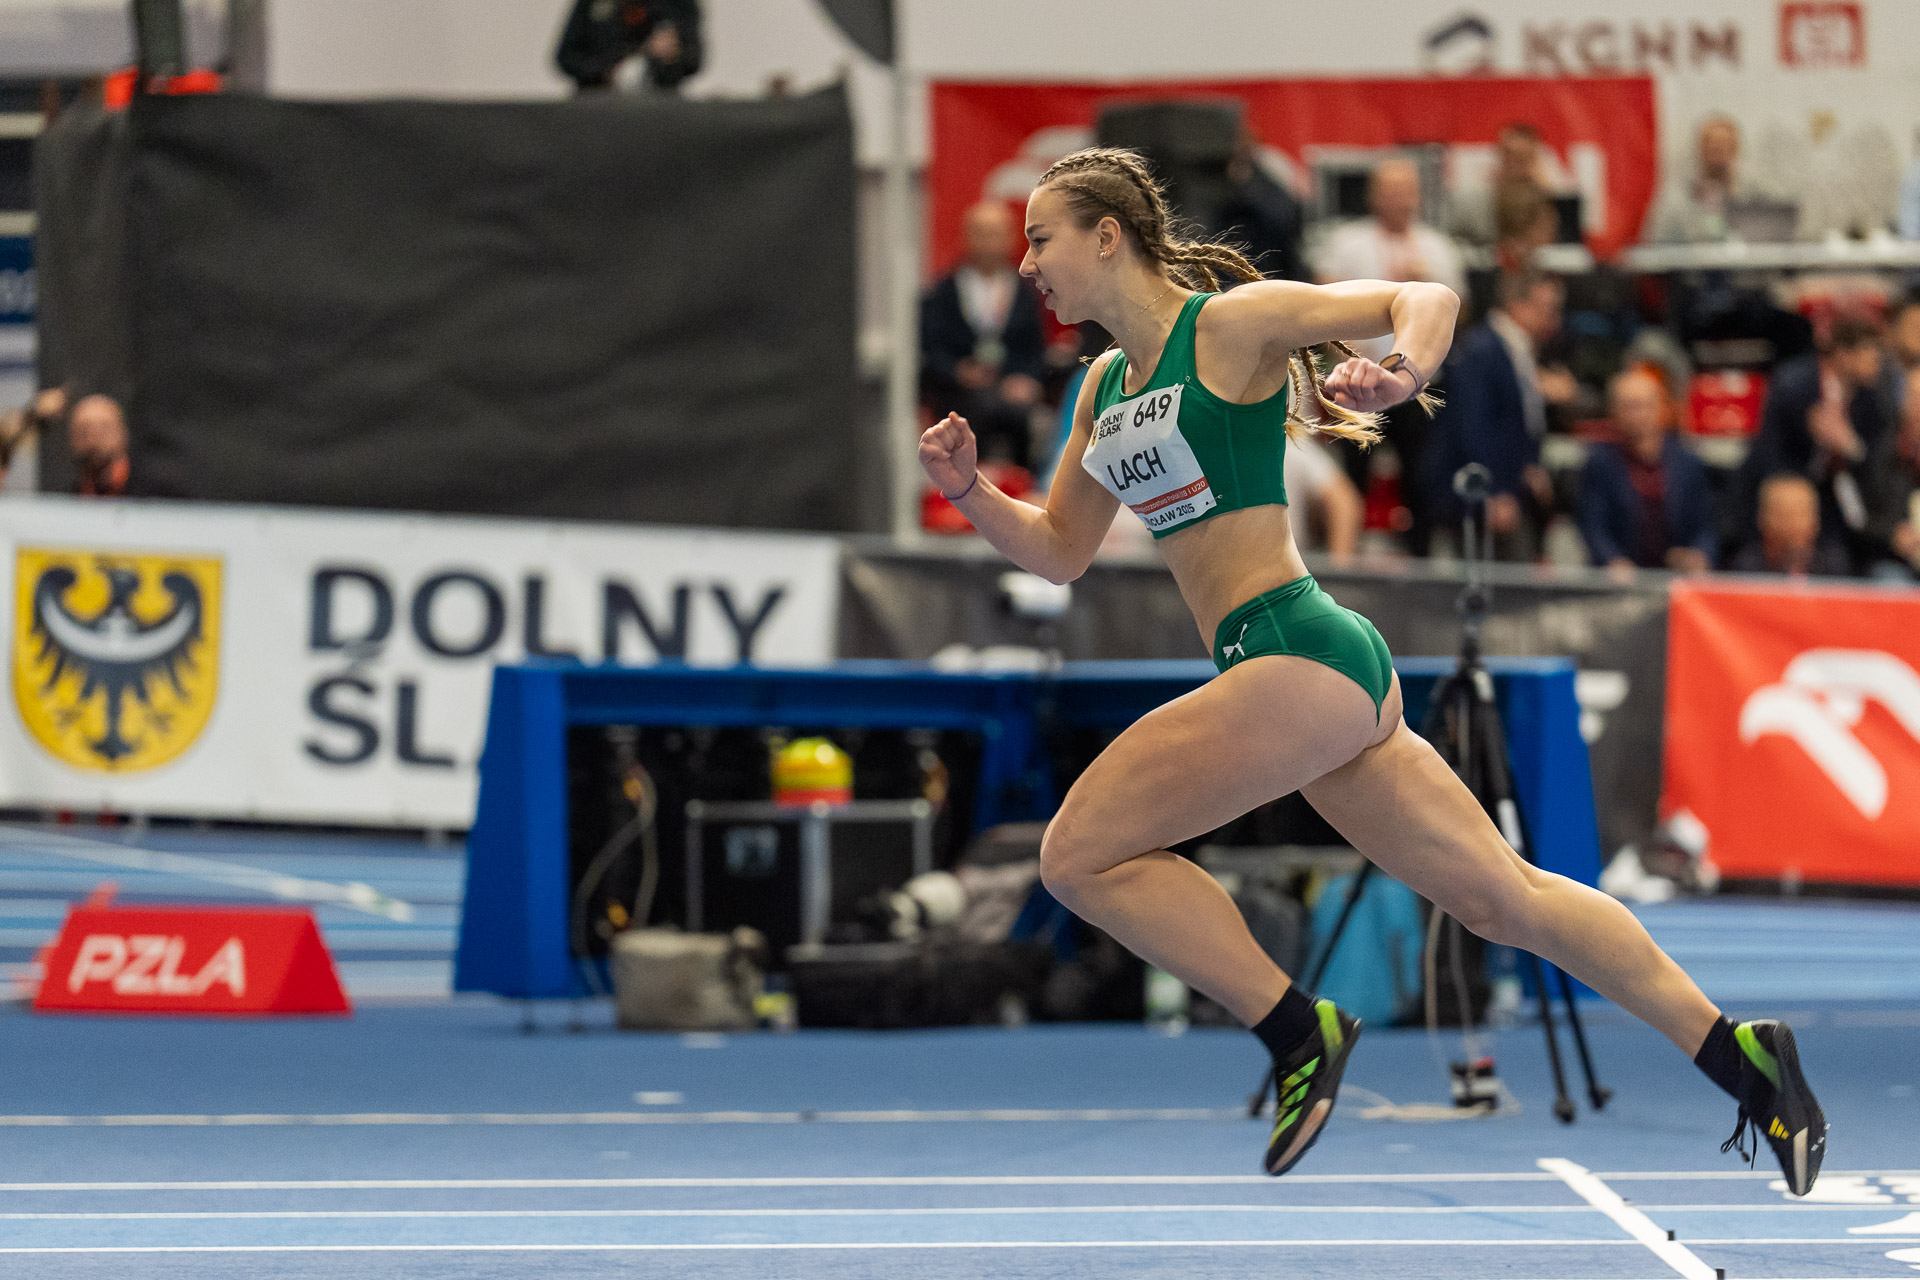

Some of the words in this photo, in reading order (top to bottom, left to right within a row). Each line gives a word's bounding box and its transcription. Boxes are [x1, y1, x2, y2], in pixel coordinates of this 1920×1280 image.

[1100, 410, 1125, 430] DOLNY
[1134, 393, 1172, 428] 649
[1106, 446, 1167, 491] LACH
[1191, 480, 1206, 493] U20
[310, 566, 786, 660] DOLNY
[303, 647, 466, 768] ŚL
[67, 934, 247, 998] PZLA
